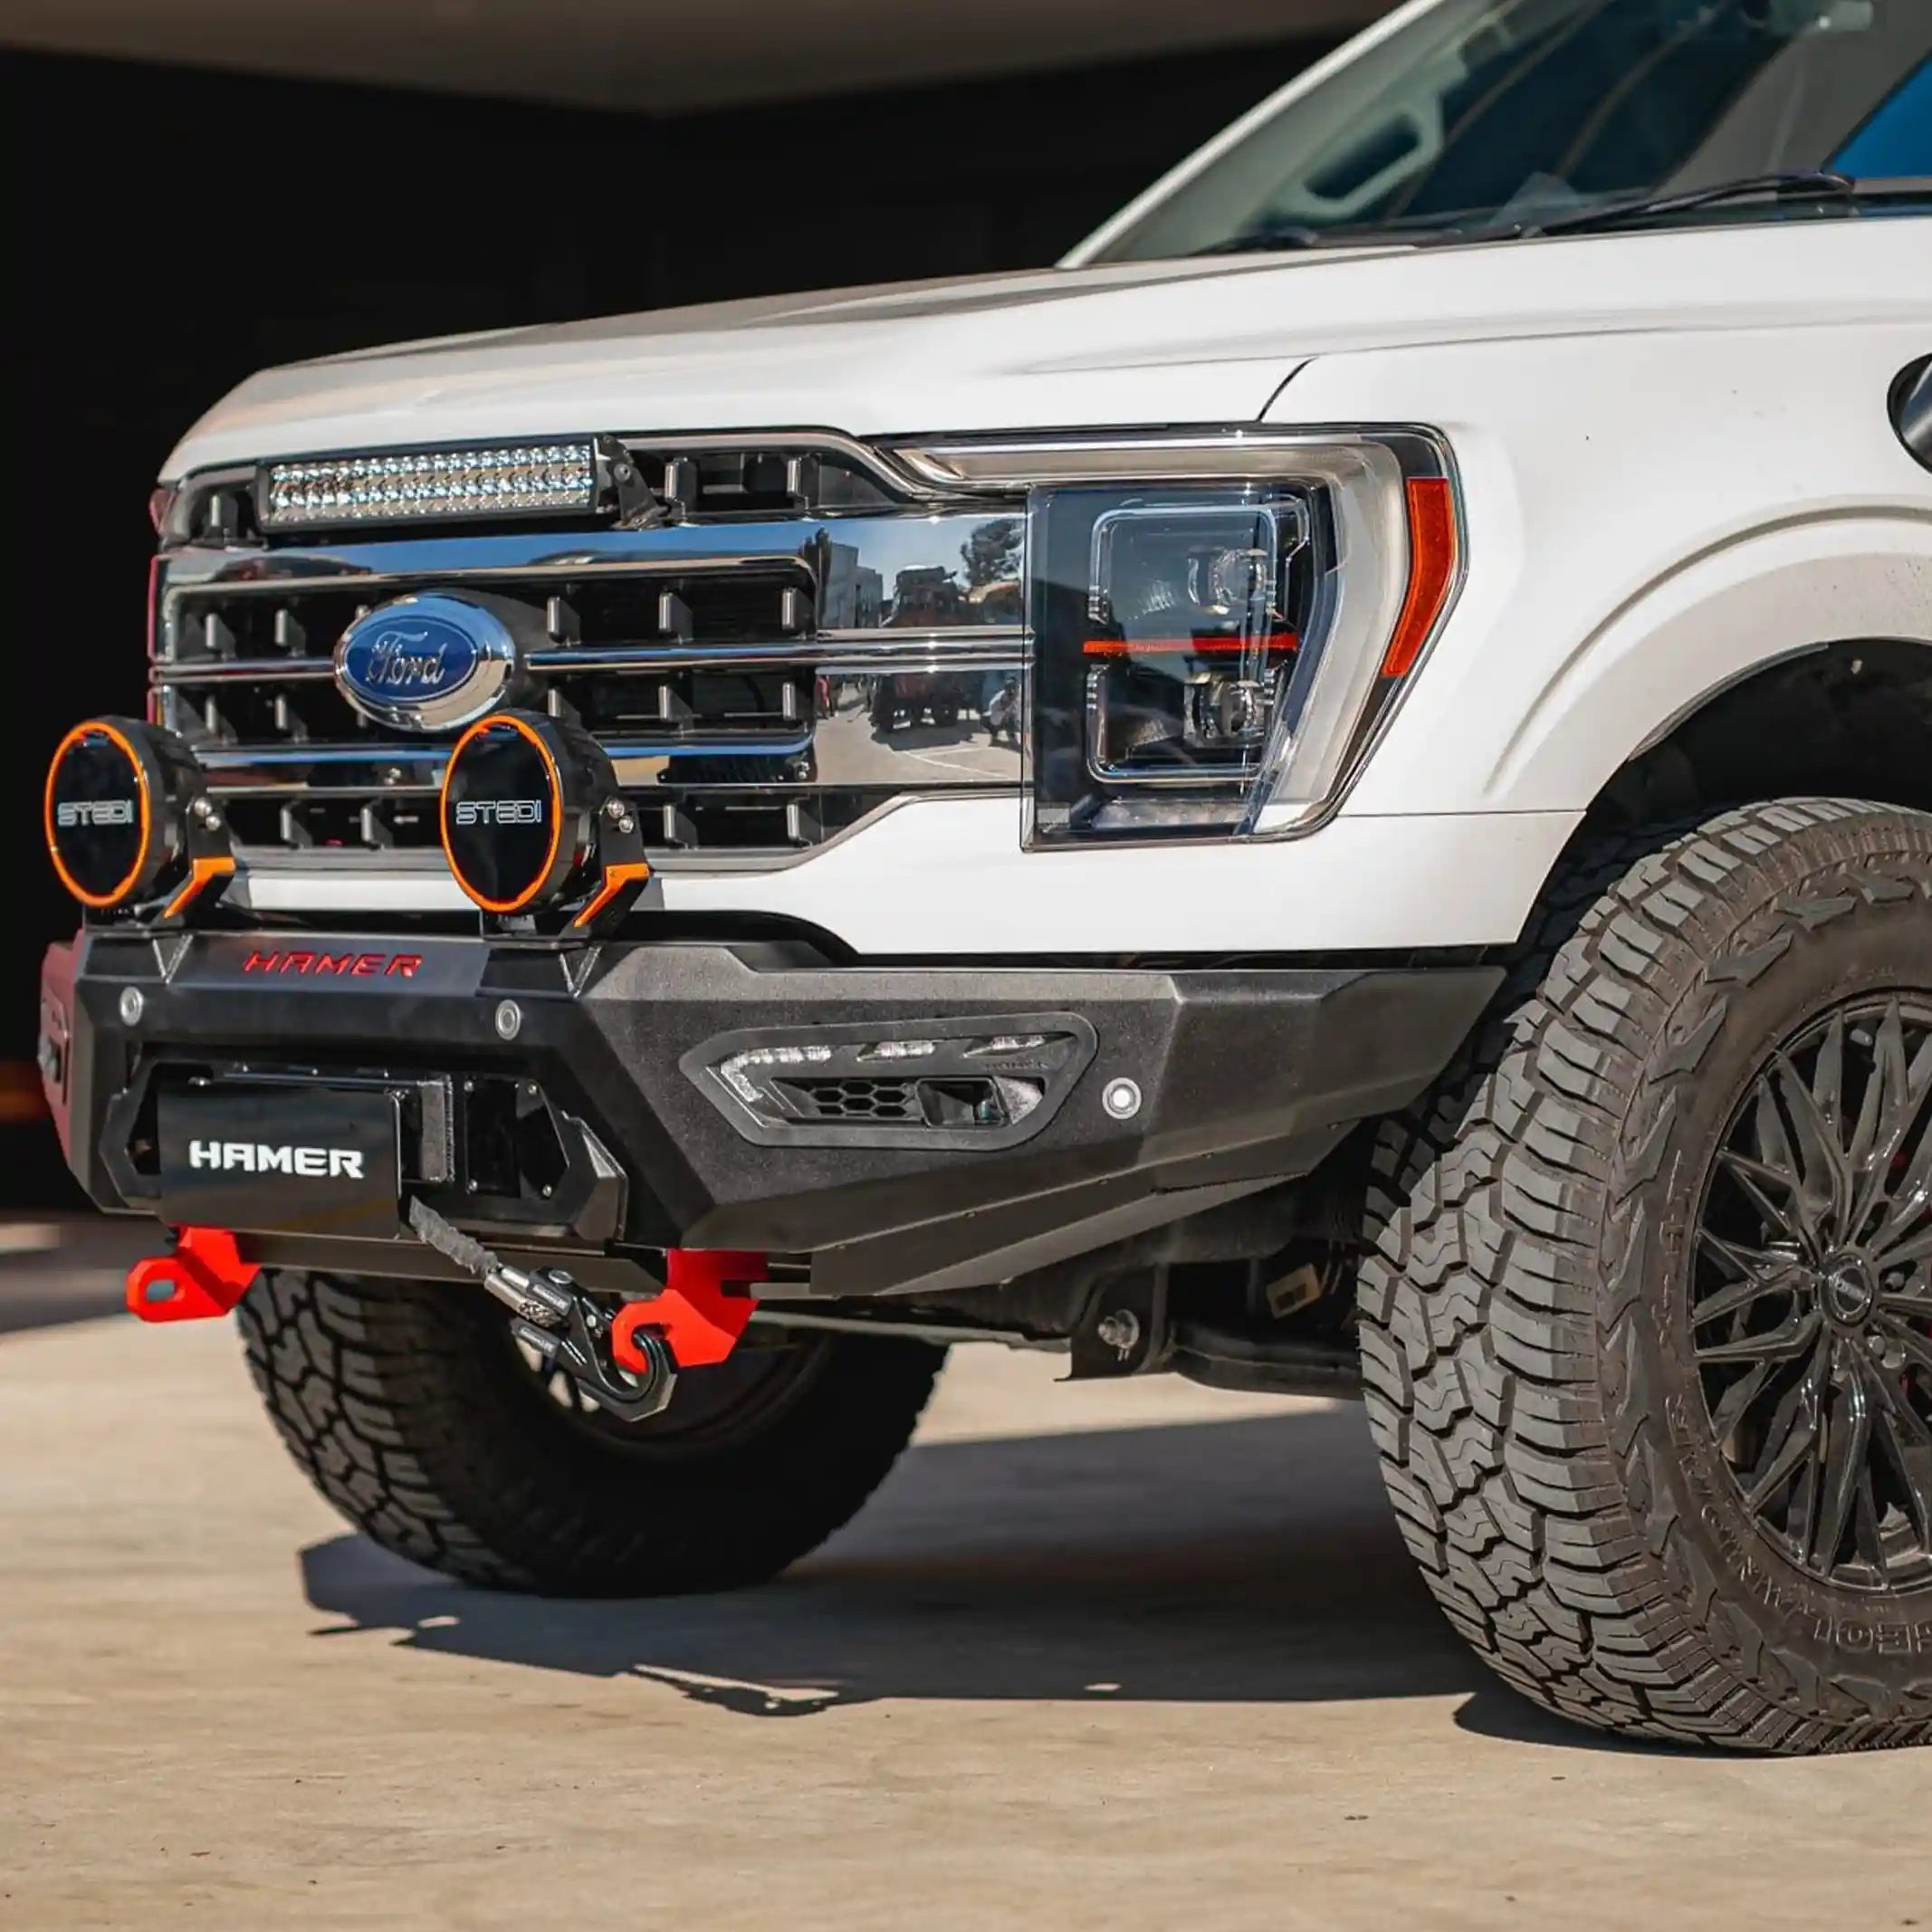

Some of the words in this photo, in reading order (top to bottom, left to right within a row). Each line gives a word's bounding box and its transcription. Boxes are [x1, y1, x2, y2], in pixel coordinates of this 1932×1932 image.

[366, 630, 447, 685] Ford
[57, 799, 133, 826] STEDI
[455, 799, 541, 825] STEDI
[244, 950, 423, 978] HAMER
[189, 1140, 364, 1179] HAMER
